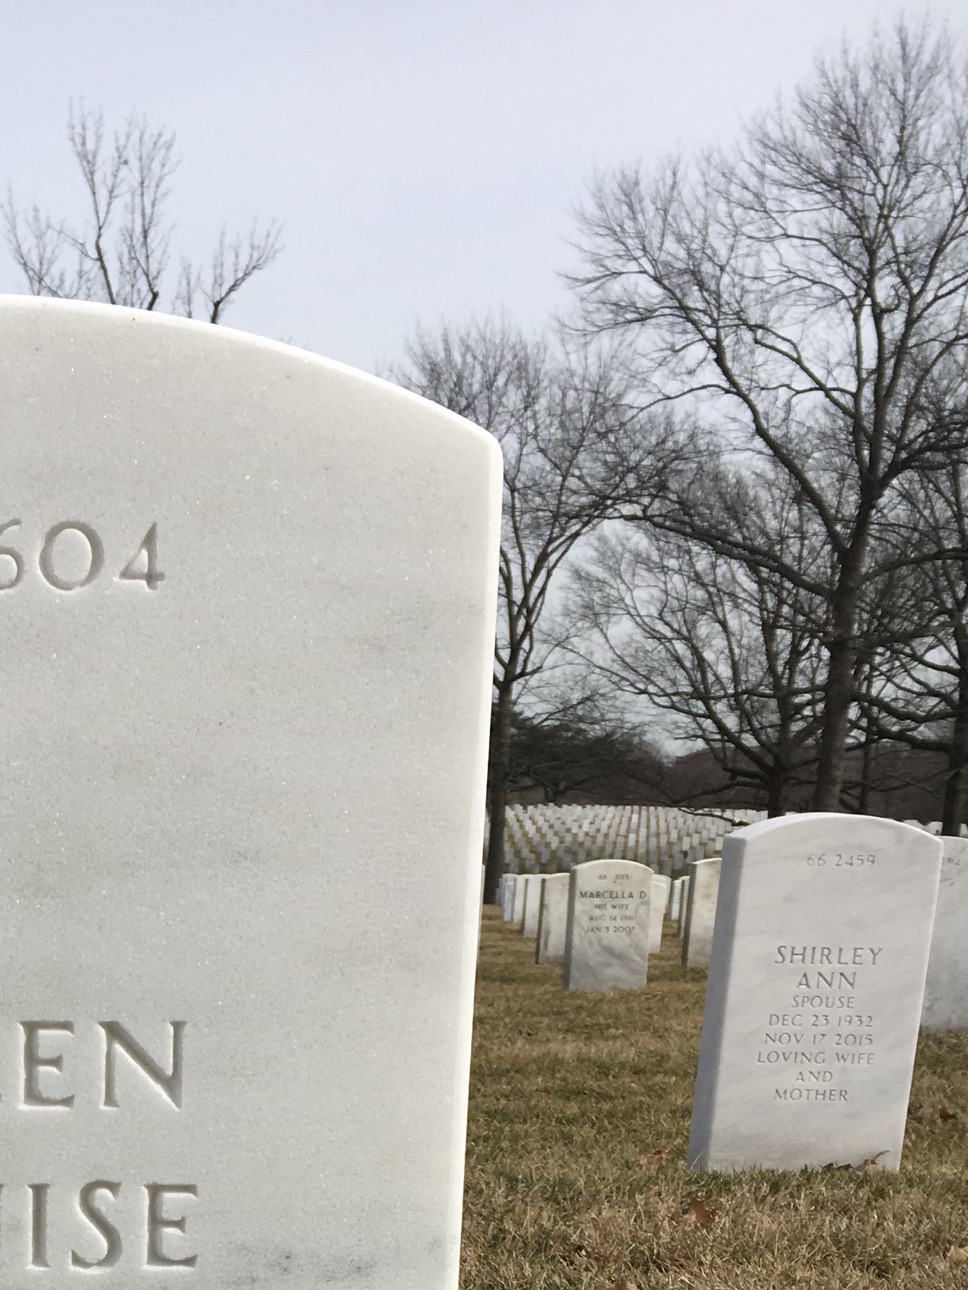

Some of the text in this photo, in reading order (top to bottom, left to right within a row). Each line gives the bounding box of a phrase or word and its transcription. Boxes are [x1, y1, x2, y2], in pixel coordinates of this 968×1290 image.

[806, 853, 876, 867] 66 2459
[579, 890, 648, 900] MARCELLA D
[594, 903, 630, 911] HIS WIFE
[774, 945, 884, 966] SHIRLEY
[796, 971, 857, 990] ANN
[791, 995, 856, 1009] SPOUSE
[768, 1013, 874, 1028] DEC 23 1932
[764, 1032, 874, 1047] NOV 17 2015
[757, 1050, 876, 1066] LOVING WIFE
[796, 1070, 834, 1083] AND
[774, 1088, 849, 1102] MOTHER
